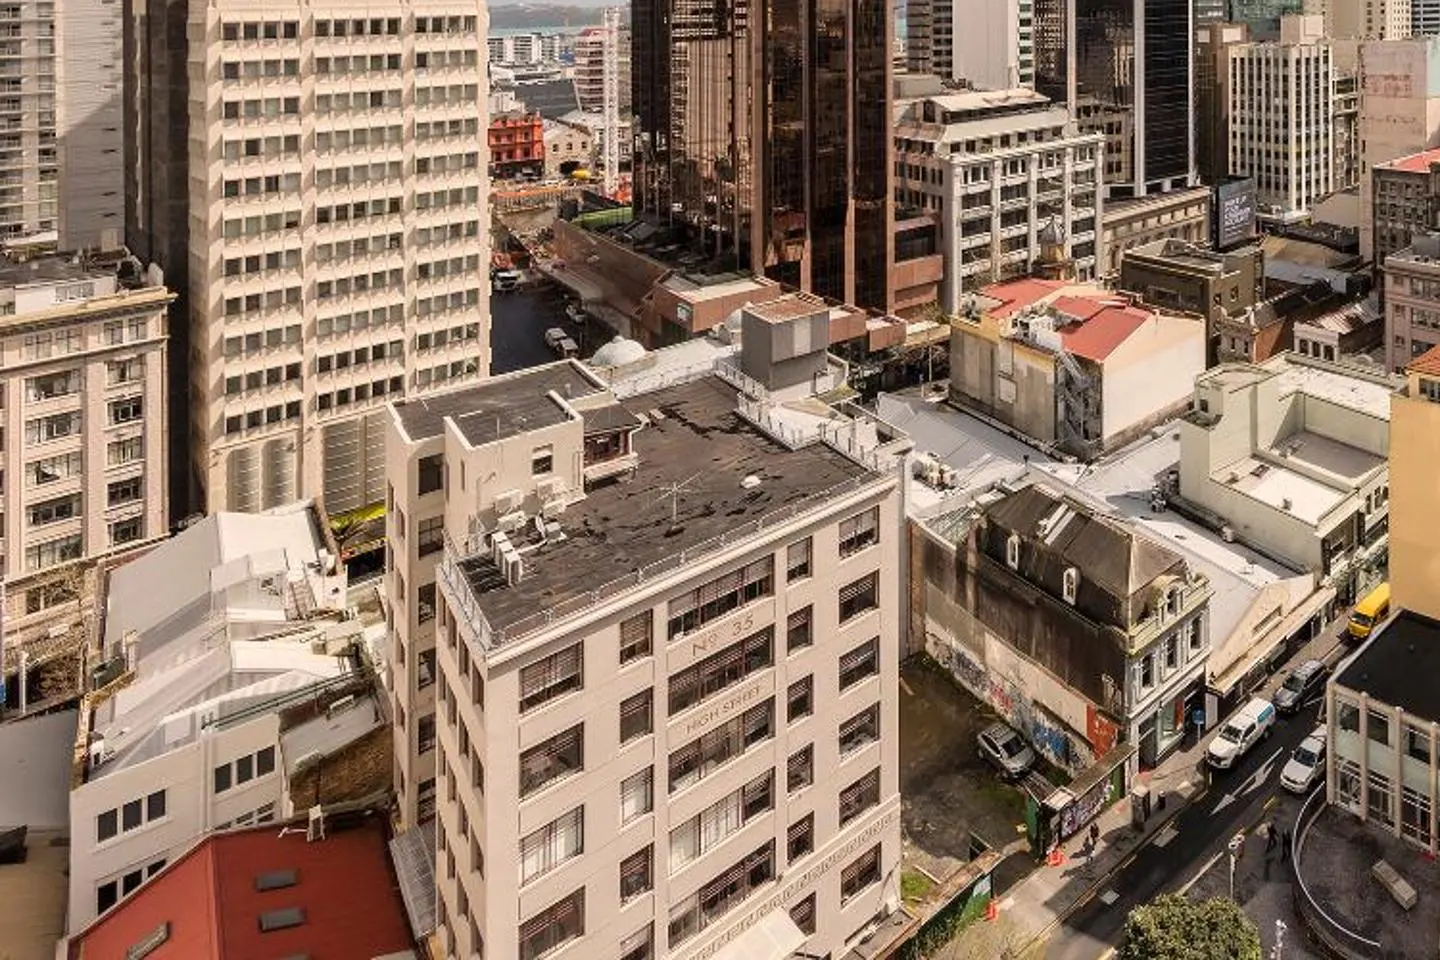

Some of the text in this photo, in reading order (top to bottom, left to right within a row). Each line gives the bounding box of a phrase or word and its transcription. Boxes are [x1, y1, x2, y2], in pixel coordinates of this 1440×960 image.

[732, 610, 755, 637] 35
[684, 685, 761, 735] HIGH STREET
